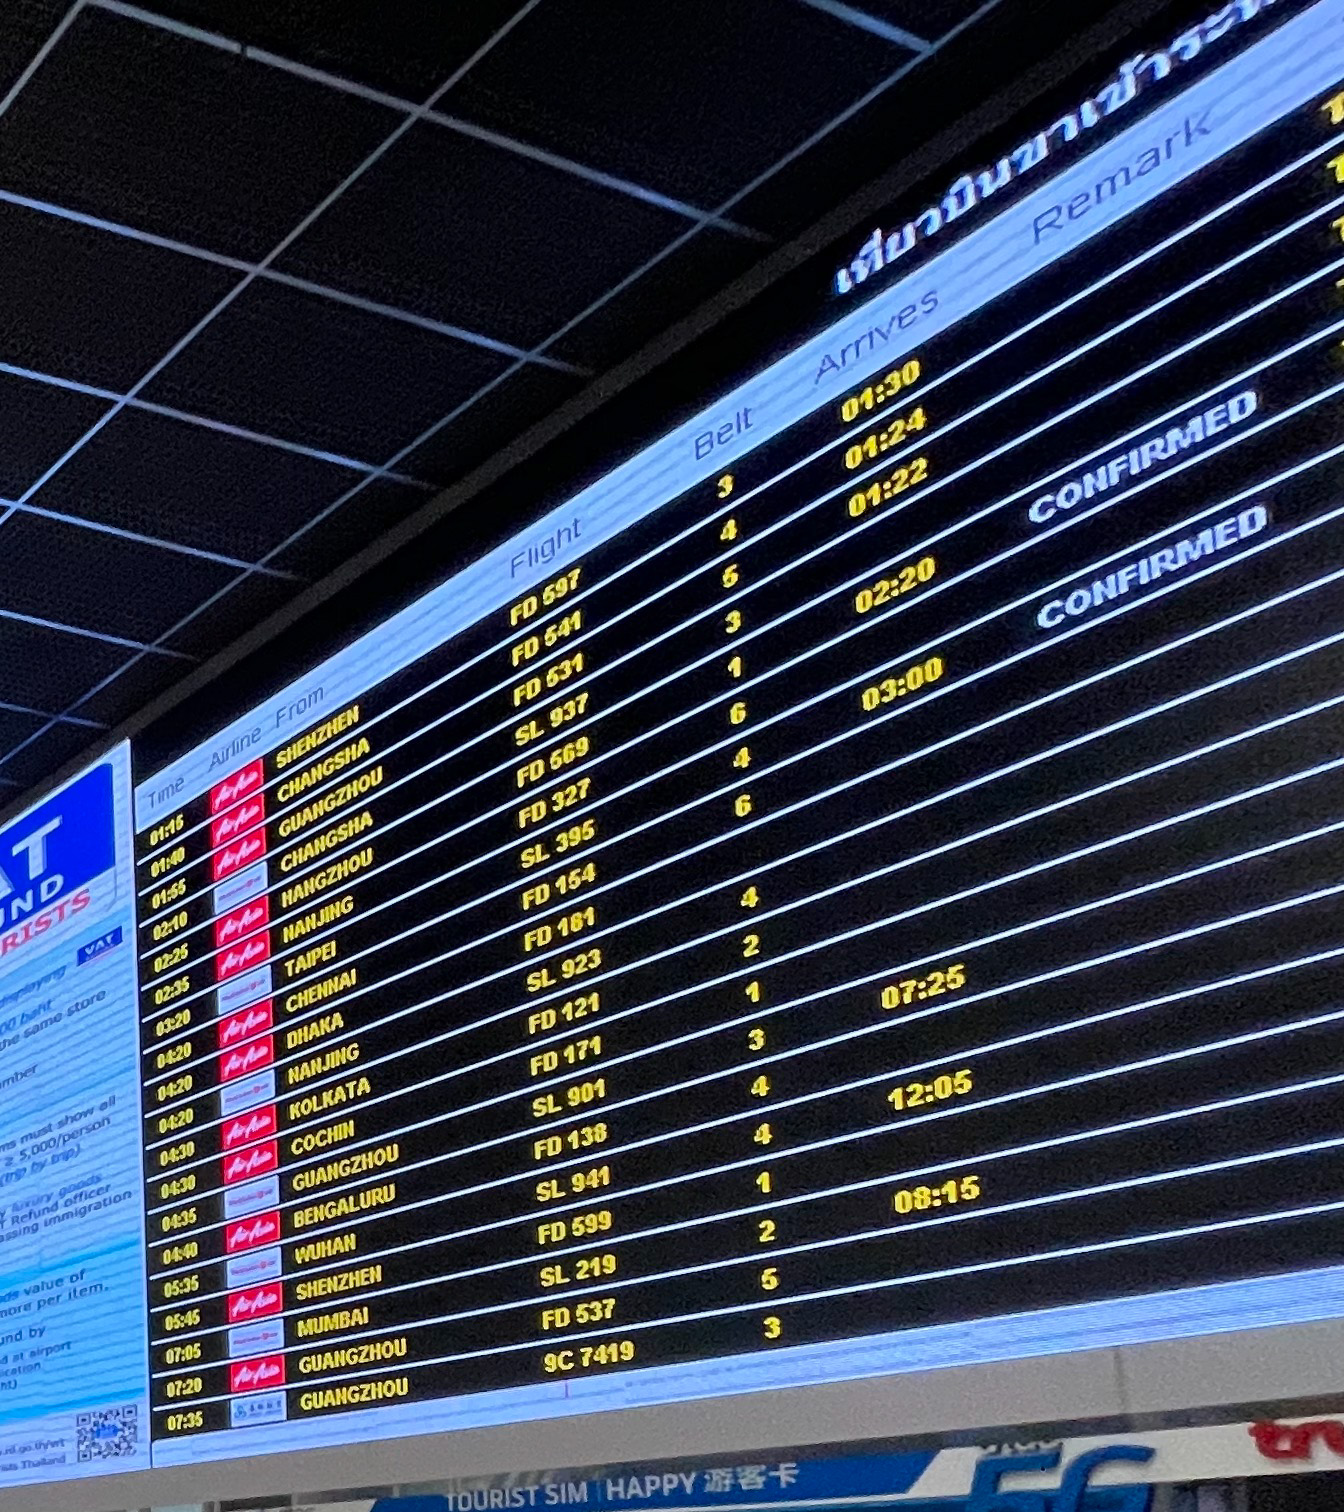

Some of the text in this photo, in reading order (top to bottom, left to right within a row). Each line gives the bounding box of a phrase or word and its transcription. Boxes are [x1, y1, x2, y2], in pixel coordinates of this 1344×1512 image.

[147, 107, 1212, 810] Time Airline From Flight Belt Arrives Remark
[275, 704, 359, 769] SHENZHEN
[510, 595, 538, 625] FD
[542, 567, 581, 605] 597
[719, 475, 734, 497] 3
[841, 359, 921, 421] 01:30
[151, 407, 927, 877] 01:40 CHANGSHA FD 541 4 01:24
[278, 767, 383, 837] GUANGZHOU
[513, 676, 542, 705] FD
[545, 653, 584, 687] 531
[722, 563, 739, 587] 5
[848, 457, 929, 517] 01:22
[281, 847, 373, 907] HANGZHOU
[516, 759, 545, 787] FD
[549, 736, 591, 769] 569
[729, 656, 742, 677] 1
[855, 556, 936, 613] 02:20
[1028, 390, 1259, 523] CONFIRMED
[152, 610, 742, 940] 02:10 CHANGSHA SL 937 3
[155, 506, 1269, 1035] 03:20 TAIPEI SL 395 4 03:00 CONFIRMED
[282, 895, 353, 943] NANJING
[519, 799, 547, 827] FD
[551, 777, 591, 813] 327
[729, 701, 747, 725] 6
[156, 1043, 192, 1069] 04:20
[285, 969, 357, 1013] CHENNAI
[521, 883, 551, 909] FD
[555, 863, 597, 893] 154
[734, 793, 753, 817] 6
[157, 906, 595, 1101] 04:20 DHAKA FD 181
[158, 887, 759, 1133] 04:20 NANJING SL 923 4
[159, 1142, 195, 1165] 04:30
[289, 1077, 371, 1119] KOLKATA
[528, 1008, 557, 1033] FD
[560, 991, 600, 1021] 121
[743, 934, 760, 957] 2
[160, 981, 761, 1197] 04:30 COCHIN FD 171 1
[292, 1144, 400, 1190] GUANGZHOU
[532, 1093, 562, 1117] SL
[566, 1079, 606, 1107] 901
[749, 1028, 765, 1051] 3
[881, 963, 967, 1009] 07:25
[162, 1075, 771, 1265] 04:40 BENGALURU FD 138 4
[294, 1233, 357, 1265] WUHAN
[535, 1179, 565, 1202] SL
[571, 1165, 611, 1191] 941
[753, 1123, 773, 1145] 4
[887, 1068, 973, 1111] 12:05
[295, 1265, 382, 1301] SHENZHEN
[537, 1221, 567, 1245] FD
[571, 1210, 613, 1237] 599
[757, 1171, 771, 1193] 1
[296, 1307, 369, 1337] MUMBAI
[539, 1265, 569, 1287] SL
[575, 1253, 617, 1280] 219
[759, 1219, 776, 1243] 2
[893, 1175, 981, 1214] 08:15
[167, 1267, 779, 1397] 07:20 GUANGZHOU FD 537 5
[299, 1378, 409, 1411] GUANGZHOU
[543, 1351, 575, 1373] 9C
[581, 1341, 635, 1367] 7419
[763, 1316, 781, 1339] 3
[545, 1481, 589, 1507] SIM
[605, 1471, 697, 1502] HAPPY
